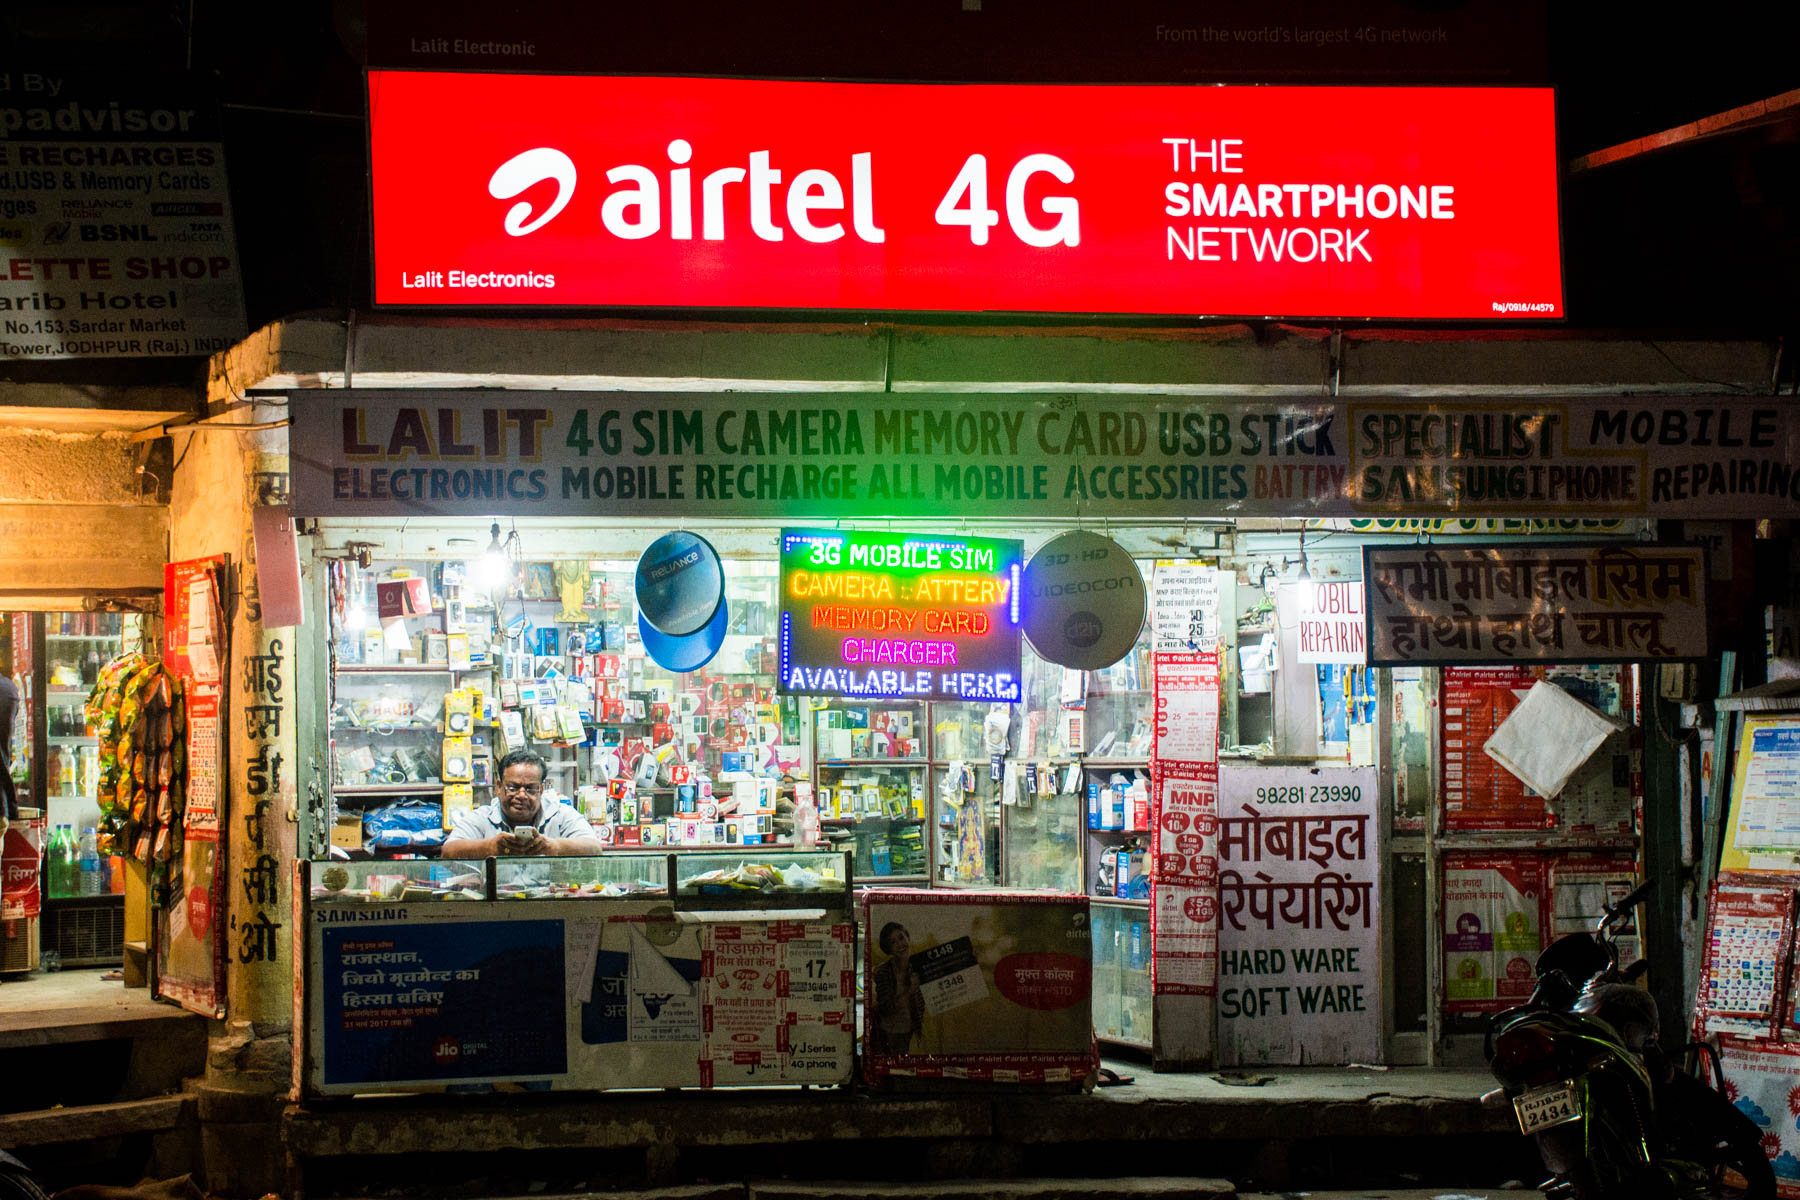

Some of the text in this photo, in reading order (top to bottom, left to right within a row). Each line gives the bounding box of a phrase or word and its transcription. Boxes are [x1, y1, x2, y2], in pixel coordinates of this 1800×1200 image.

[410, 37, 536, 57] Lalit Electronic
[1156, 25, 1448, 47] From the world's largest 4G network
[24, 73, 64, 96] By
[19, 147, 216, 167] RECHARGES
[1161, 138, 1244, 174] THE
[62, 173, 76, 190] &
[82, 172, 152, 194] Memory
[158, 172, 211, 190] Cards
[600, 138, 1081, 248] airtel 4G
[0, 199, 37, 219] ges
[1164, 182, 1456, 220] SMARTPHONE
[80, 224, 158, 242] BSNL
[190, 223, 222, 231] TATA
[1168, 227, 1373, 263] NETWORK
[0, 256, 231, 281] ETTE SHOP
[402, 271, 556, 289] Lalit Electronics
[80, 291, 178, 310] Hotel
[6, 318, 187, 336] No.153,Sardar Market
[147, 339, 189, 355] (Raj.)
[342, 407, 553, 463] LALIT
[566, 409, 1336, 458] 4G SIM CAMERA MEMORY CARD USB STICK
[1361, 412, 1561, 459] SPECIALIST
[1589, 409, 1778, 448] MOBILE
[333, 466, 547, 501] ELECTRONICS
[561, 464, 1346, 501] MOBILE RECHARGE ALL MOBILE ACCESSRIES BATTRY
[810, 541, 994, 571] 3G MOBILE SIM
[1045, 548, 1109, 566] 3D HD
[793, 573, 1011, 604] CAMERA ATTERY
[1591, 548, 1699, 604] सिम
[1304, 583, 1364, 615] OBIL
[815, 606, 988, 635] MEMORY CARD
[1188, 623, 1204, 636] 25
[1572, 611, 1676, 657] चालू
[844, 639, 957, 665] CHARGER
[789, 667, 1011, 698] AVAILABLE HERE
[1171, 790, 1215, 807] MNP
[1256, 785, 1362, 806] 98281 23990
[1218, 802, 1370, 869] मोबाइल
[1218, 869, 1373, 931] रिपेयरिंग
[316, 908, 408, 923] SAMSUNG
[341, 951, 424, 967] राजस्थान,
[805, 958, 827, 979] 17
[1221, 949, 1286, 976] HARD
[1291, 947, 1361, 974] WARE
[341, 968, 386, 987] जियो
[455, 968, 481, 982] का
[342, 990, 394, 1008] हिस्सा
[1221, 985, 1366, 1019] SOFT WARE
[435, 1042, 459, 1056] Jio
[806, 1060, 837, 1071] phone
[1529, 1102, 1570, 1127] 2434
